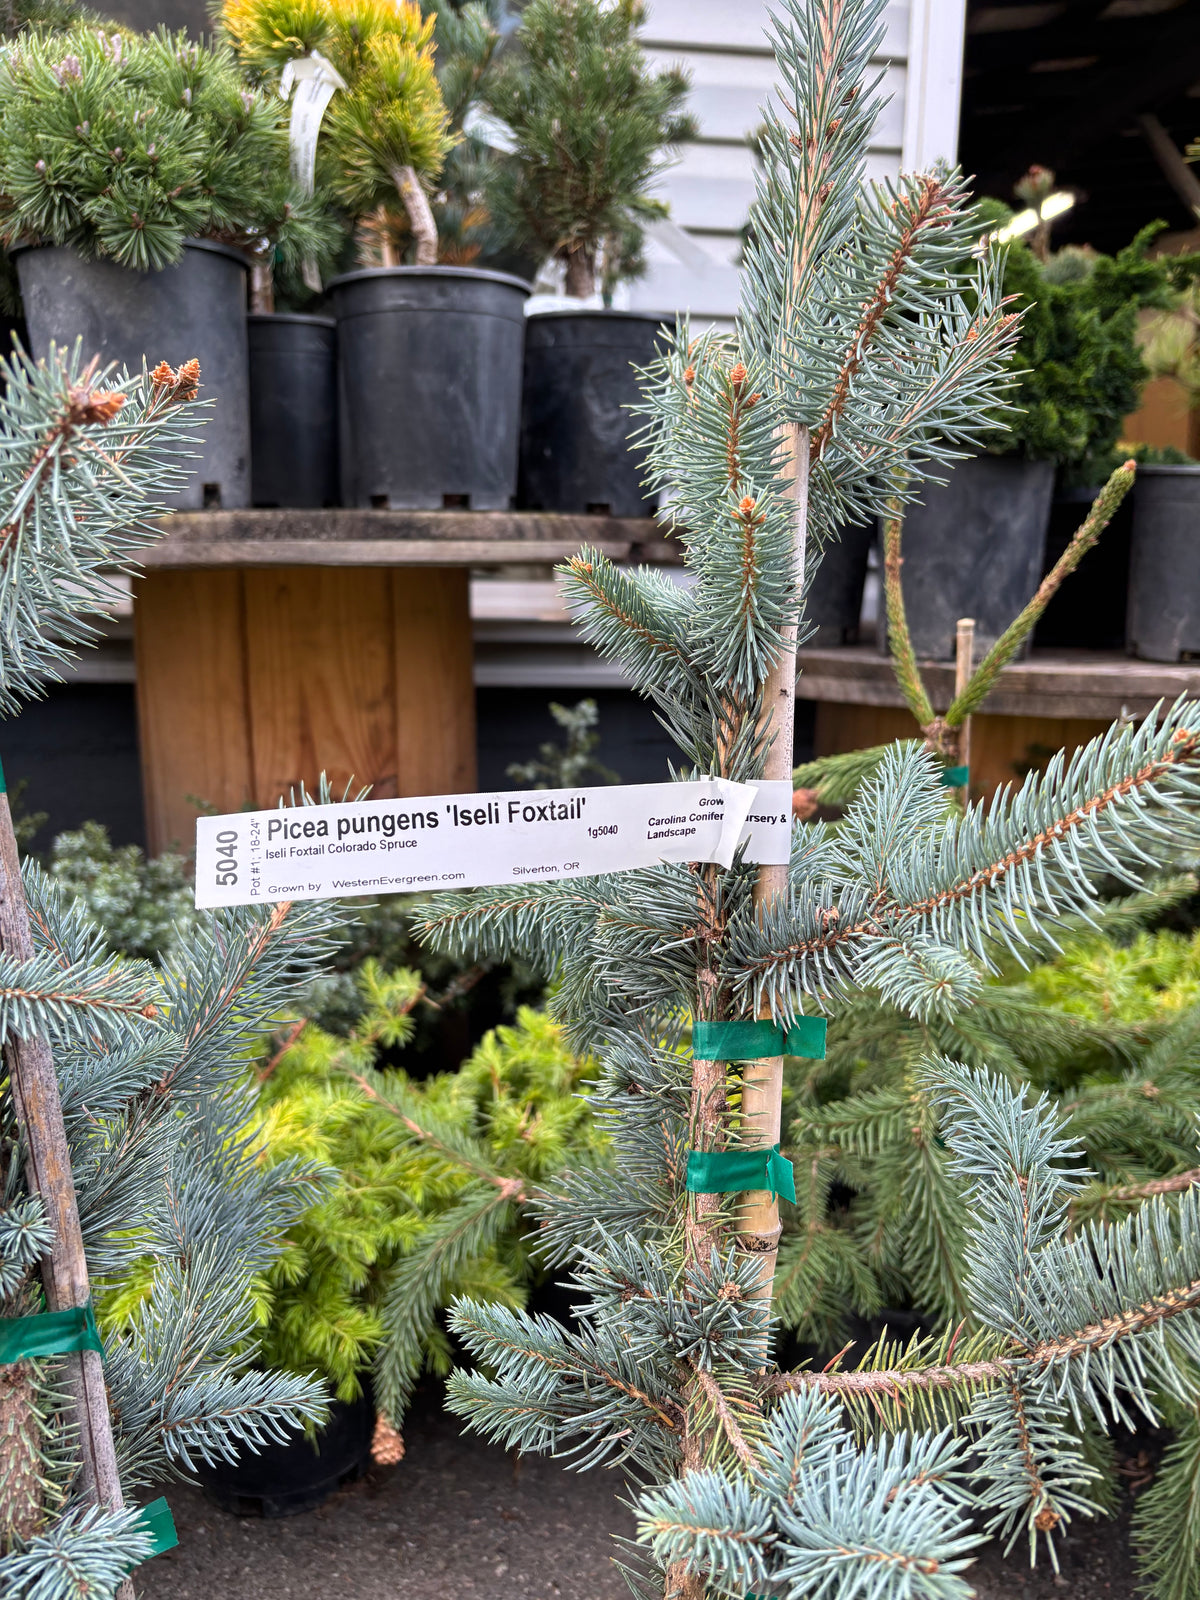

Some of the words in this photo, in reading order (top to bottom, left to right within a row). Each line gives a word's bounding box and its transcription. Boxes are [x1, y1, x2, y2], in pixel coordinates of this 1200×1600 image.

[698, 798, 724, 807] Grow
[267, 818, 329, 841] Picea
[337, 811, 439, 840] pungens
[446, 802, 500, 827] 'Iseli
[507, 797, 586, 823] Foxtail'
[648, 814, 687, 827] Carolina
[779, 813, 787, 823] &
[250, 818, 261, 852] 18-24"
[587, 824, 619, 839] 1g5040
[646, 826, 697, 840] Landscape
[215, 830, 239, 886] 5040
[265, 848, 287, 859] Iseli
[290, 845, 325, 857] Foxtail
[327, 841, 377, 854] Colorado
[379, 839, 418, 852] Spruce
[512, 864, 560, 876] Silverton,
[563, 861, 580, 871] OR
[250, 877, 261, 896] Pot
[268, 885, 305, 894] Grown
[308, 882, 322, 892] by
[332, 872, 466, 888] WesternEvergreen.com
